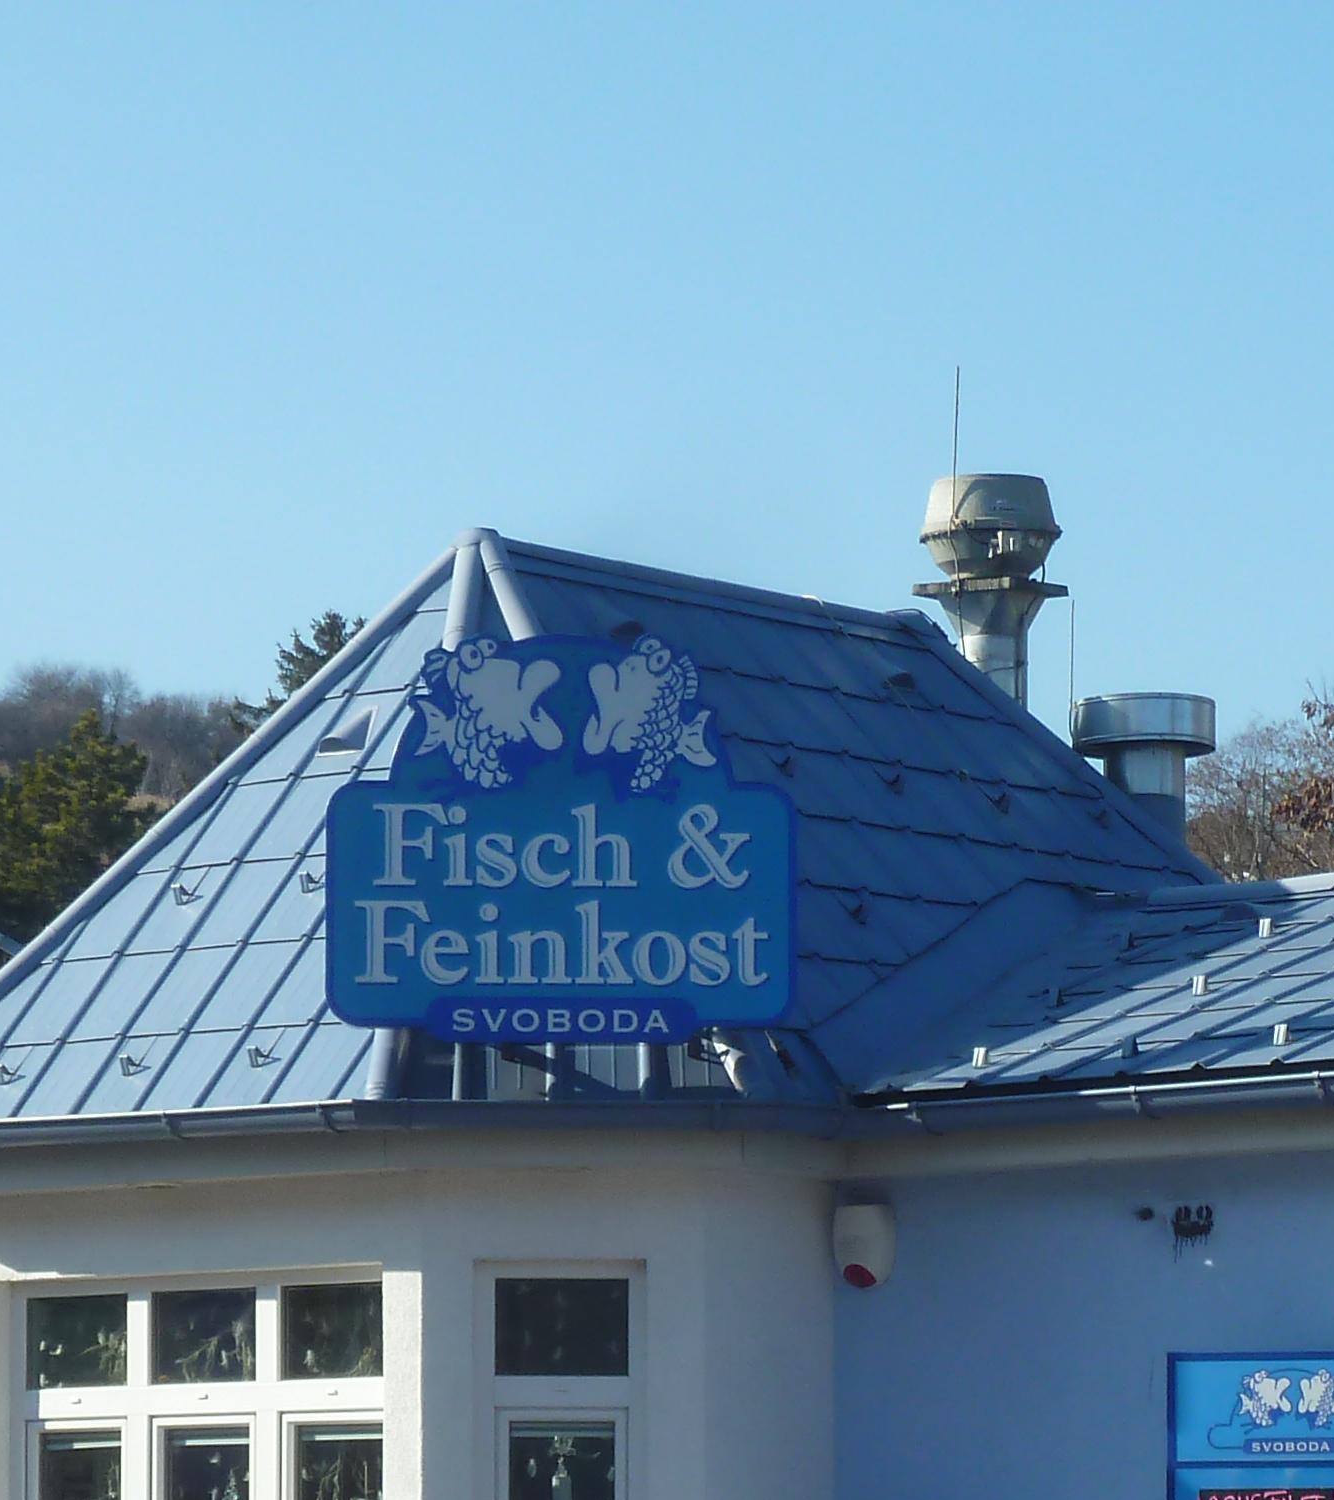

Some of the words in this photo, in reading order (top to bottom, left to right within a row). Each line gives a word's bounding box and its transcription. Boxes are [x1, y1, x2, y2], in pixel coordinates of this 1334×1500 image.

[372, 803, 638, 888] Fisch
[667, 804, 751, 889] &
[354, 900, 770, 986] Feinkost
[452, 1008, 669, 1033] SVOBODA
[1251, 1441, 1331, 1453] SVOBODA
